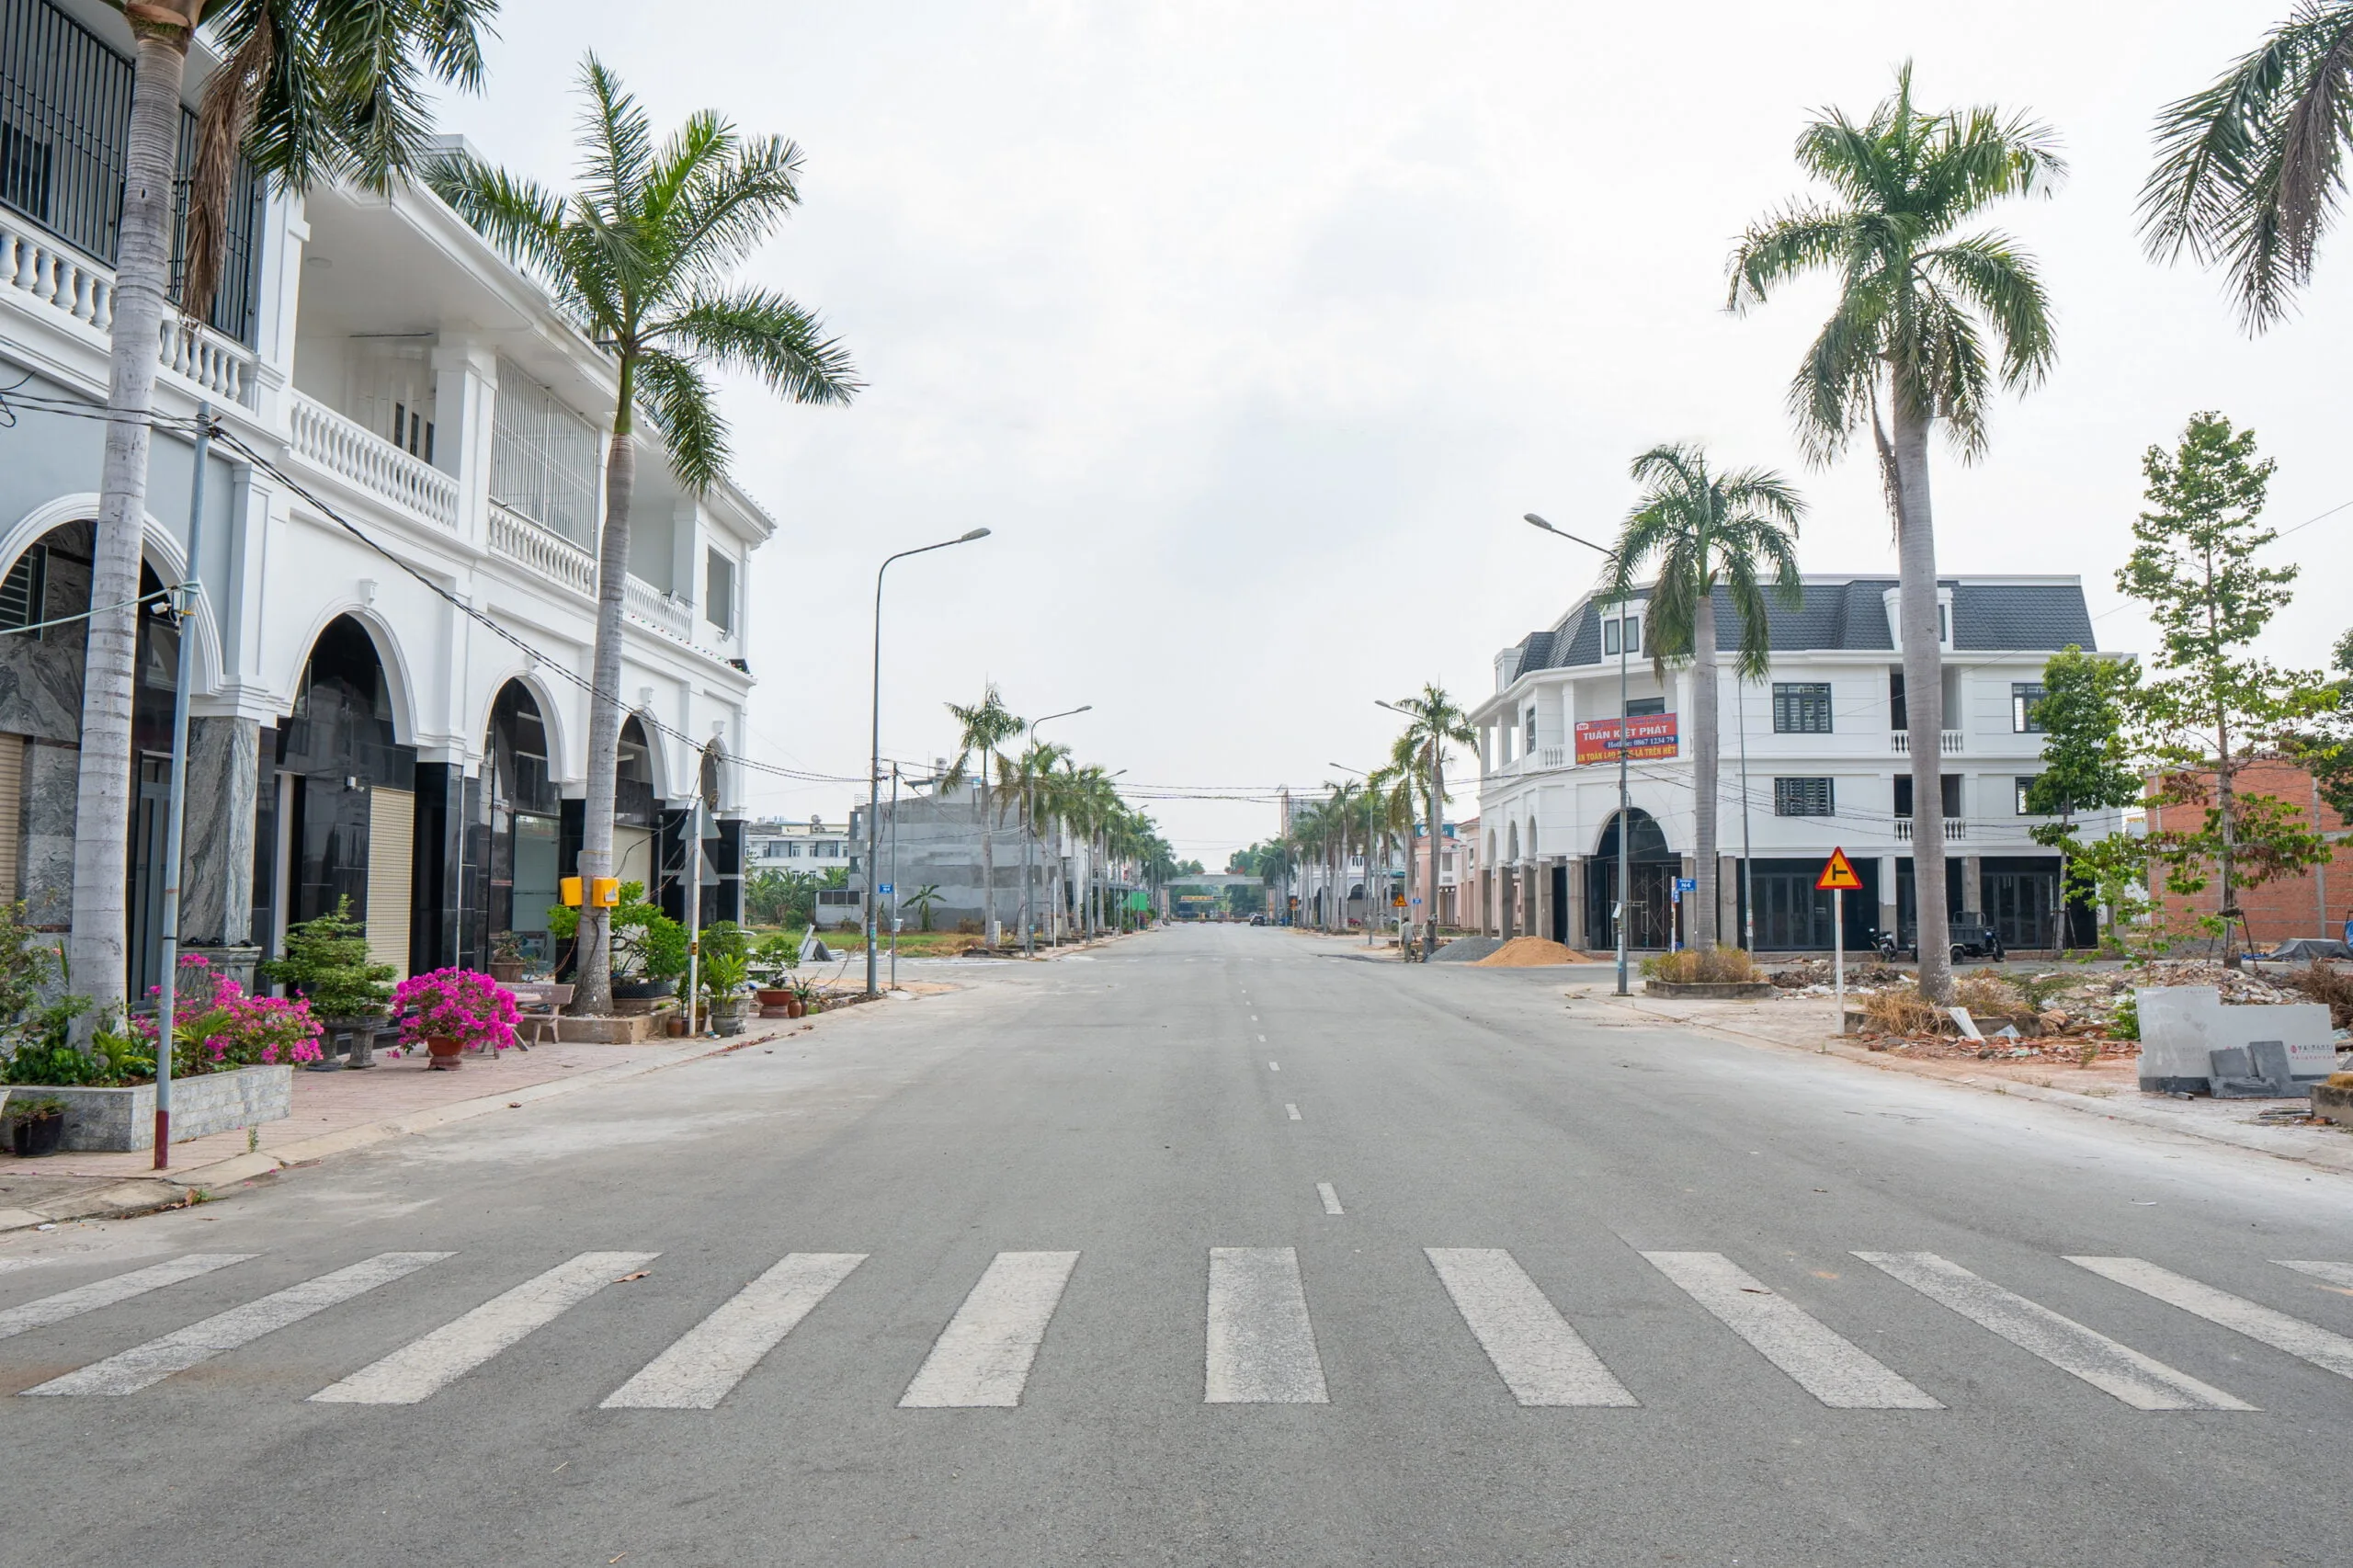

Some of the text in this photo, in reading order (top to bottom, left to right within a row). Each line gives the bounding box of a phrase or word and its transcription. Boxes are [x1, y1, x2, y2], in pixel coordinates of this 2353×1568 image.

[1613, 727, 1636, 738] KỆT
[1640, 724, 1668, 735] PHÁT
[1633, 738, 1648, 746] 0867
